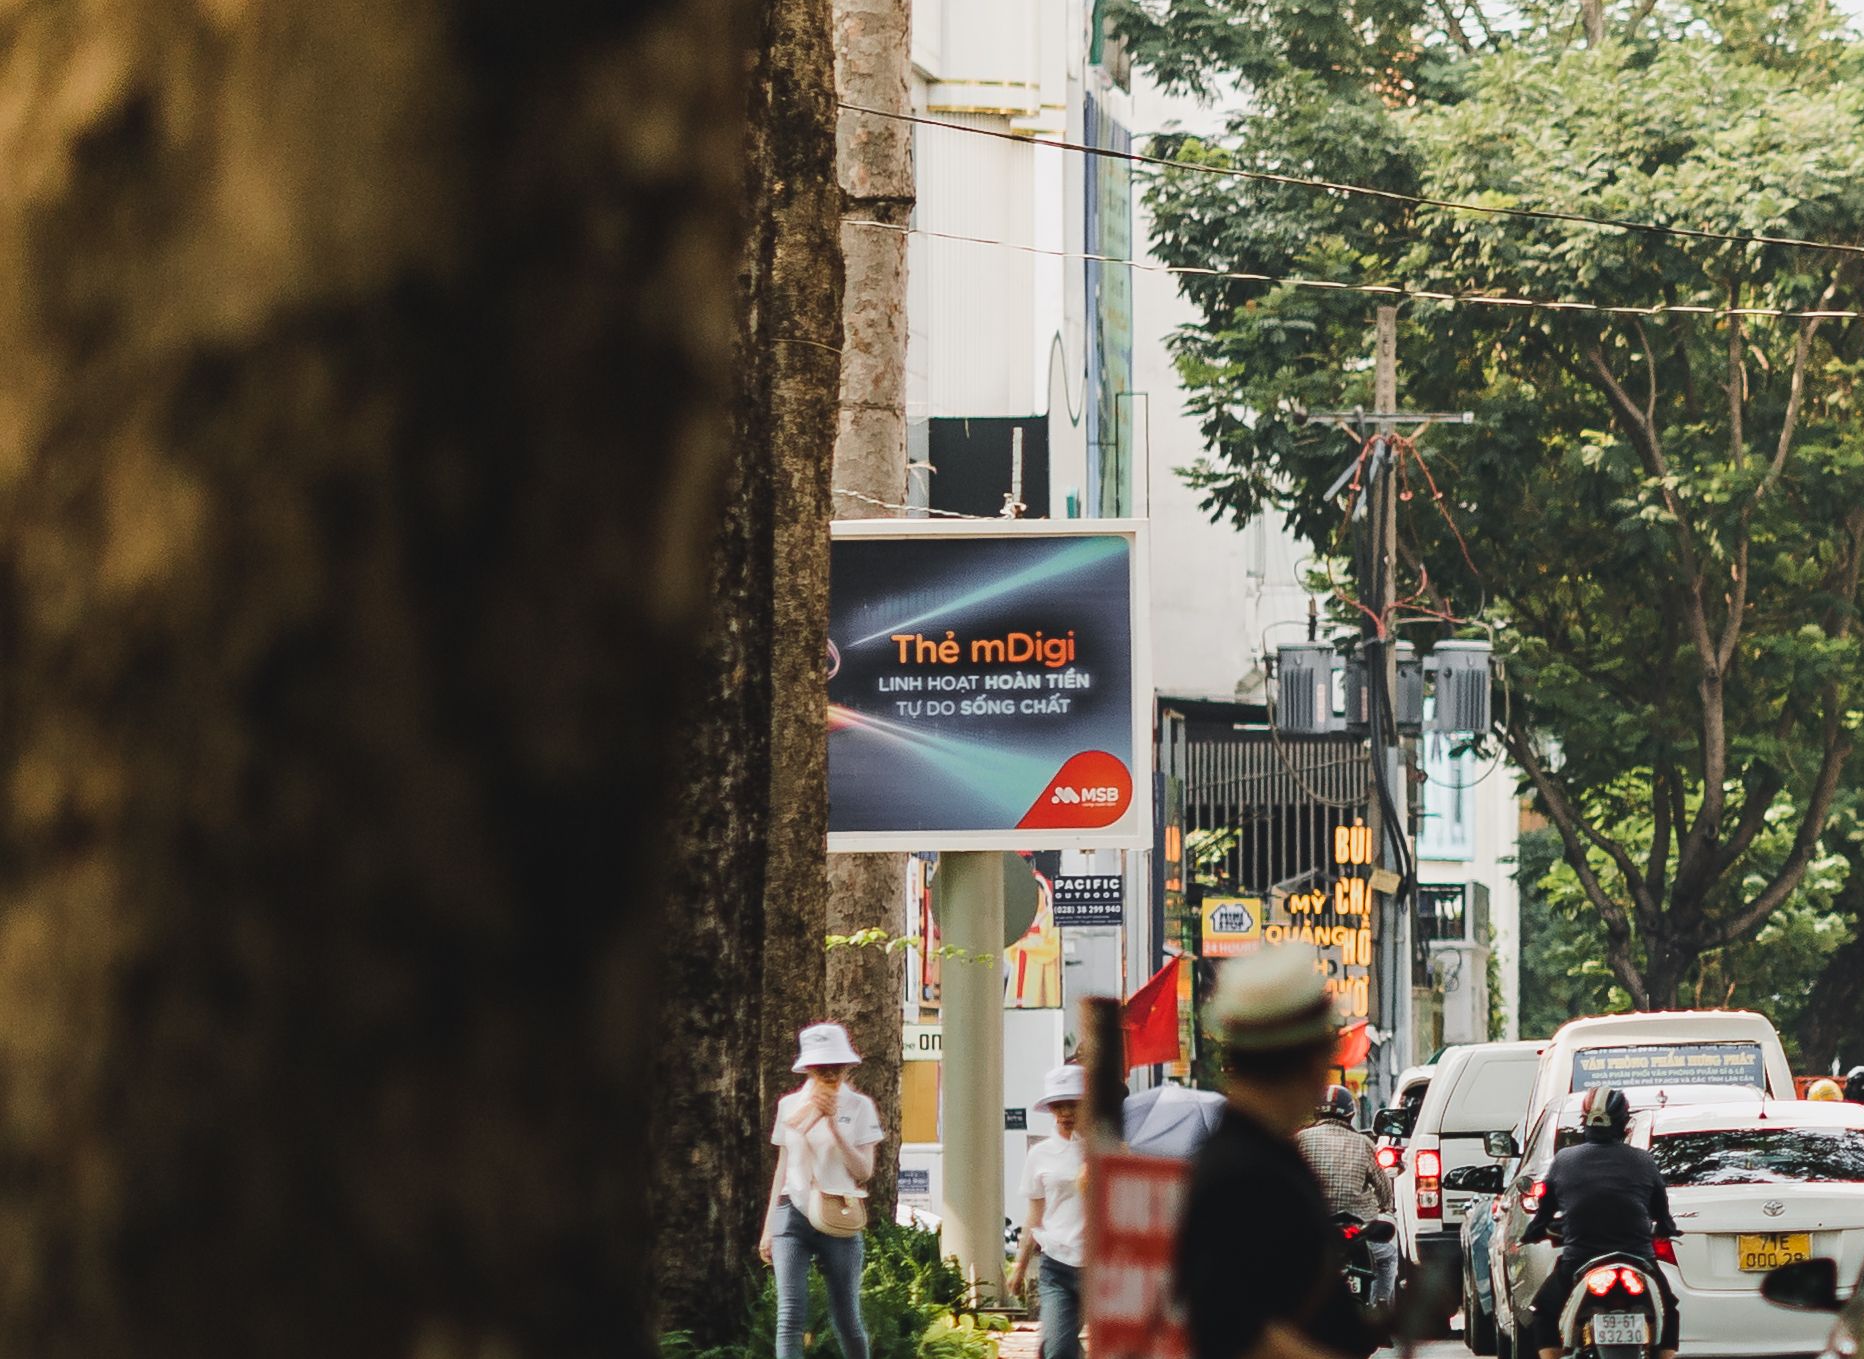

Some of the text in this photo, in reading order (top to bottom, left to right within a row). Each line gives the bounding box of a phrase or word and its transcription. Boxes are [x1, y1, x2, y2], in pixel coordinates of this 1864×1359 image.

[891, 630, 1076, 668] Thẻ mDigi
[879, 668, 1090, 693] LINH HOẠT HOÀN TIỀN
[897, 693, 1070, 718] TỰ DO SỐNG CHẤT
[1082, 787, 1118, 803] MSB
[1055, 879, 1120, 890] PACIFIC
[1055, 891, 1120, 899] OUTDOOR
